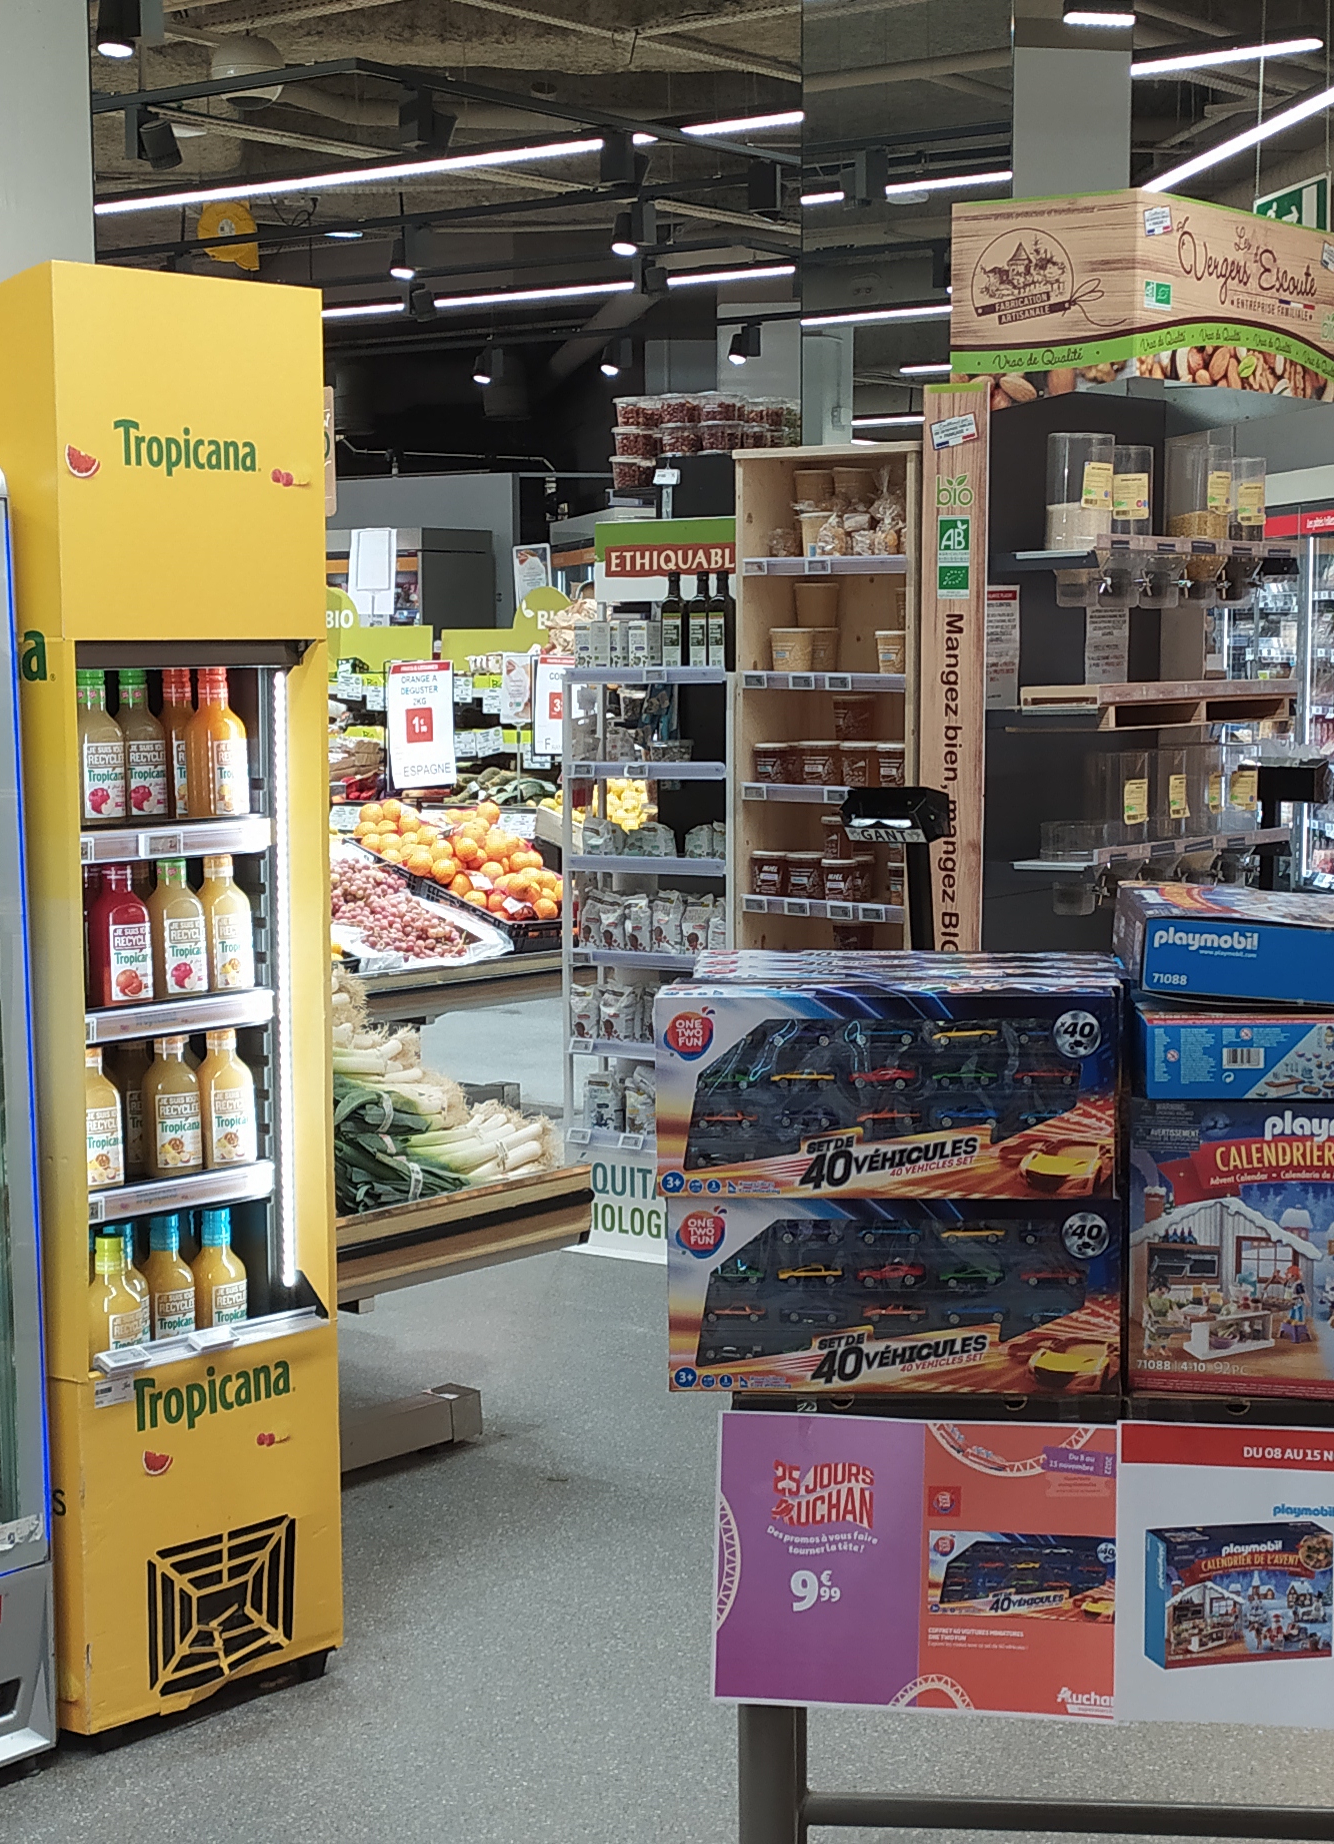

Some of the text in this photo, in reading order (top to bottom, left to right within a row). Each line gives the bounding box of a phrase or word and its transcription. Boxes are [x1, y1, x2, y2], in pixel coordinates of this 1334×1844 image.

[995, 293, 1048, 312] FABRICATION
[1236, 298, 1308, 321] ENTREPRISE FAMILIALE
[1001, 305, 1051, 324] ARTISANALE
[992, 346, 1084, 370] Vrac de Qualité
[113, 418, 258, 477] Tropicana
[935, 475, 974, 507] bio
[940, 528, 966, 550] AB
[939, 612, 964, 725] Mangez
[401, 674, 437, 684] ORANGE A
[401, 685, 439, 695] DEGUSTER
[403, 763, 452, 777] ESPAGNE
[942, 730, 963, 793] bien,
[861, 829, 907, 842] GANT
[1153, 928, 1259, 952] playmobil
[1198, 949, 1258, 960] www.playmobil.com
[1152, 973, 1188, 986] 71088
[676, 1018, 703, 1030] ONE
[676, 1028, 703, 1039] TWO
[678, 1036, 703, 1047] FUN
[807, 1134, 855, 1154] SET DE
[797, 1137, 980, 1190] 40 VÉHICULES
[889, 1154, 975, 1177] 40 VEHICLES SET
[666, 1176, 682, 1188] 3+
[1209, 1175, 1235, 1187] Advent
[1236, 1172, 1268, 1183] Calendar
[1321, 1171, 1331, 1179] de
[687, 1218, 714, 1229] ONE
[687, 1227, 714, 1237] TWO
[689, 1235, 714, 1246] FUN
[817, 1332, 865, 1351] SET DE
[810, 1334, 988, 1384] 40 VÉHICULES
[899, 1352, 985, 1373] 40 VEHICLES SET
[1136, 1359, 1171, 1371] 71088
[678, 1372, 694, 1383] 3+
[133, 1360, 290, 1432] Tropicana
[1243, 1446, 1262, 1458] DU
[1264, 1447, 1282, 1459] 08
[1284, 1448, 1303, 1460] AU
[1305, 1449, 1321, 1461] 15
[772, 1459, 876, 1496] 25 JOURS
[770, 1486, 875, 1530] AUCHAN
[766, 1525, 879, 1545] Des promos à vous faire
[788, 1543, 837, 1556] tourner la
[1221, 1539, 1283, 1556] playmobil
[1201, 1552, 1301, 1571] CALENDRIER DE L'AVENT
[790, 1569, 841, 1612] 9 € 99
[989, 1597, 1013, 1613] 40
